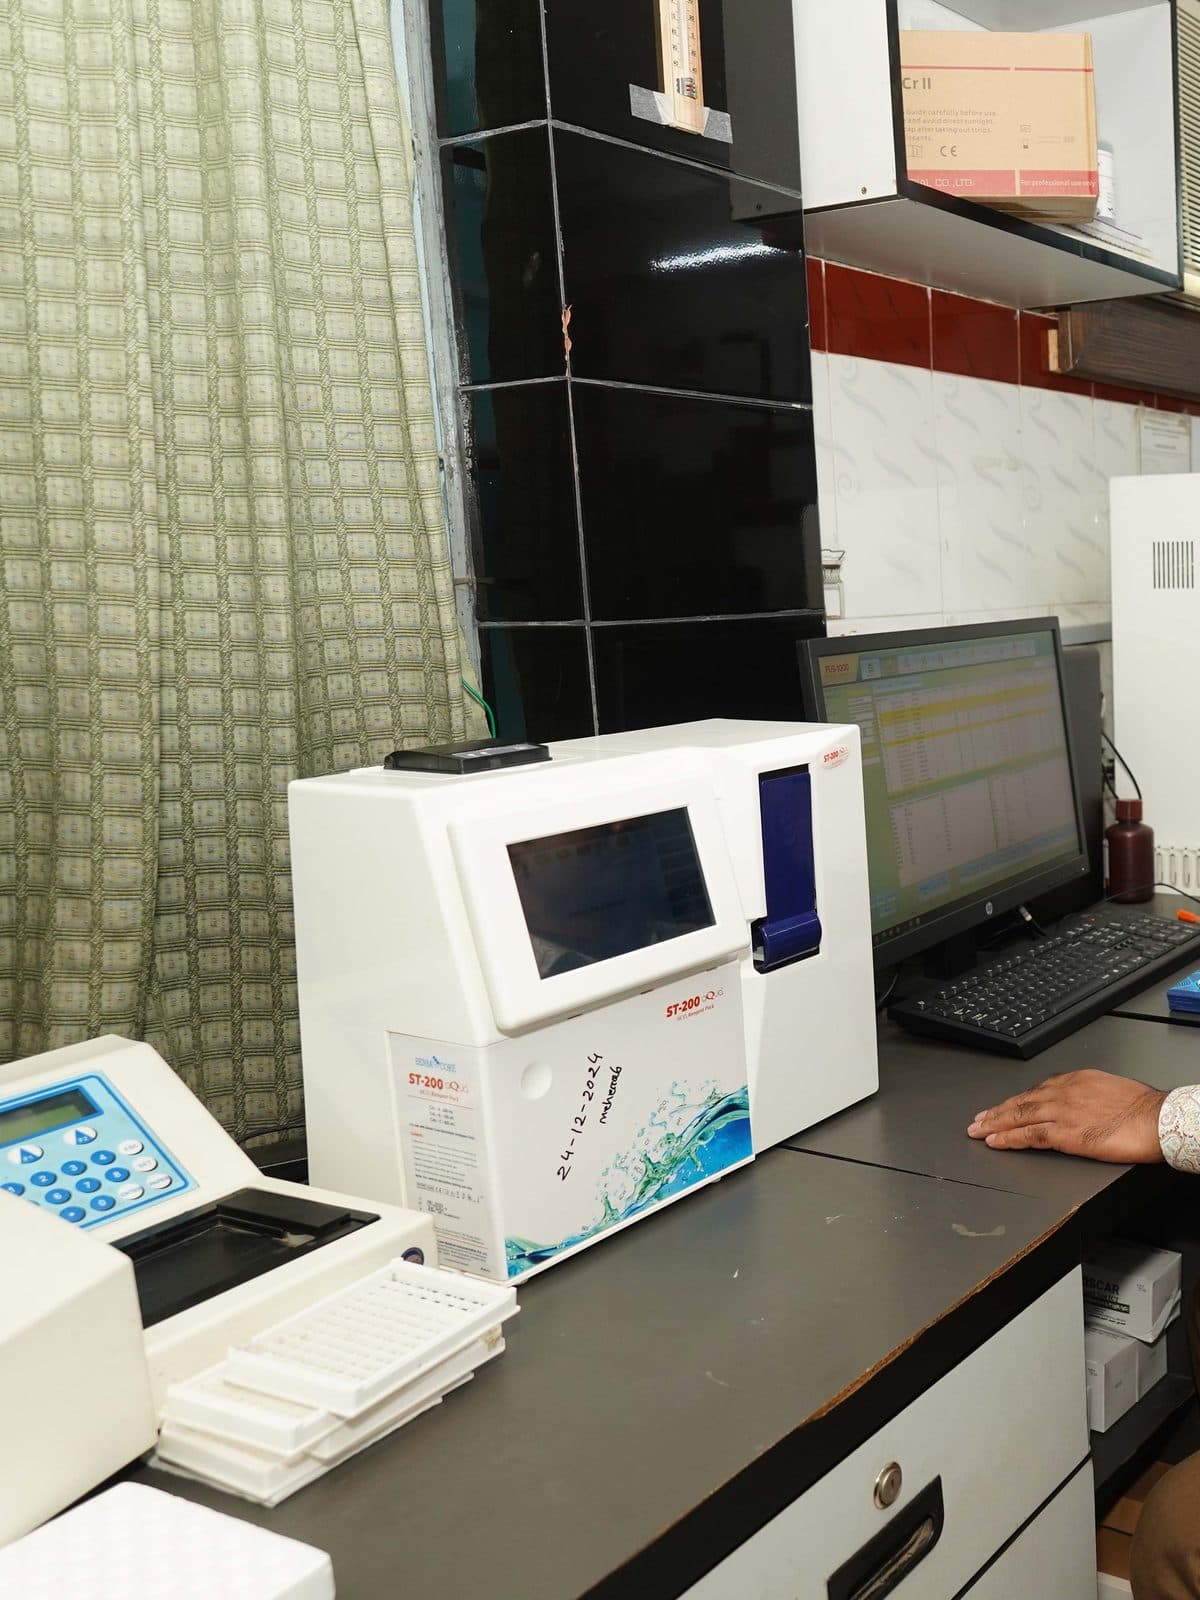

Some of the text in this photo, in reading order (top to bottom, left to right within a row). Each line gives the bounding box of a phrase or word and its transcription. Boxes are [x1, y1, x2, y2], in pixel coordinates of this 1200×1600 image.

[935, 126, 957, 136] taking
[666, 996, 700, 1018] ST-200
[409, 1072, 443, 1090] ST-200
[556, 1053, 604, 1181] 24-12-2024
[69, 1163, 79, 1172] 3
[39, 1174, 49, 1183] 2
